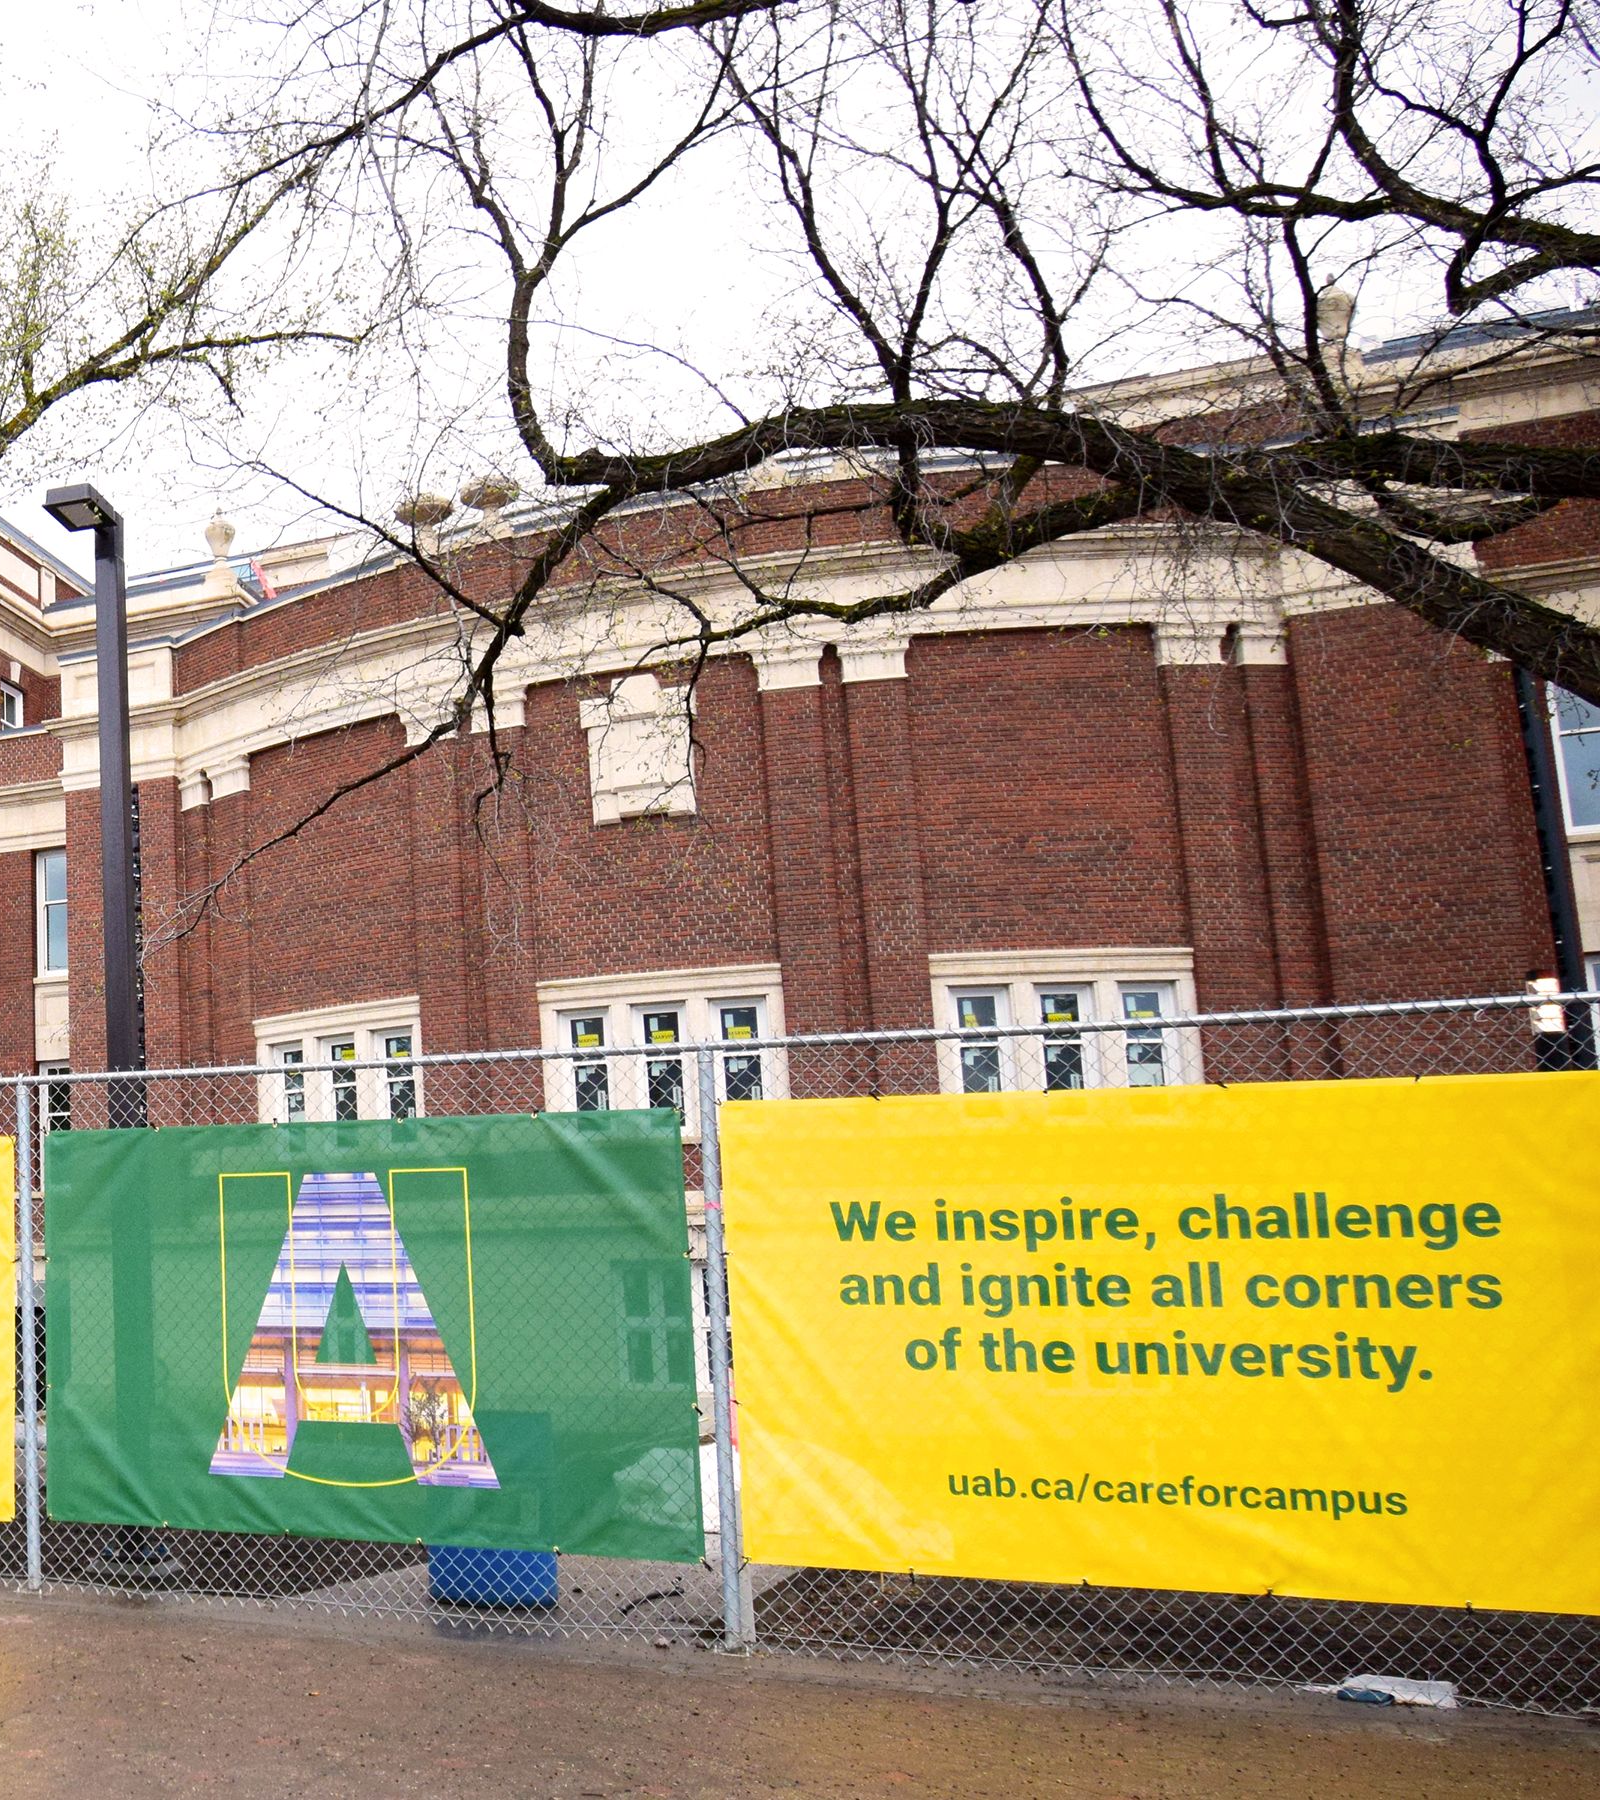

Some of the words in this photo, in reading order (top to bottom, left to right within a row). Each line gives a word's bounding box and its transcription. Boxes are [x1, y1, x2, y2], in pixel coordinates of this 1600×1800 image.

[829, 1200, 917, 1243] We
[934, 1195, 1157, 1253] inspire,
[1177, 1191, 1502, 1252] challenge
[839, 1261, 942, 1307] and
[960, 1262, 1132, 1319] ignite
[1151, 1260, 1224, 1308] all
[1244, 1272, 1504, 1310] corners
[904, 1326, 962, 1372] of
[978, 1327, 1076, 1374] the
[1094, 1329, 1434, 1394] university.
[948, 1467, 1409, 1521] uab.ca/careforcampus
